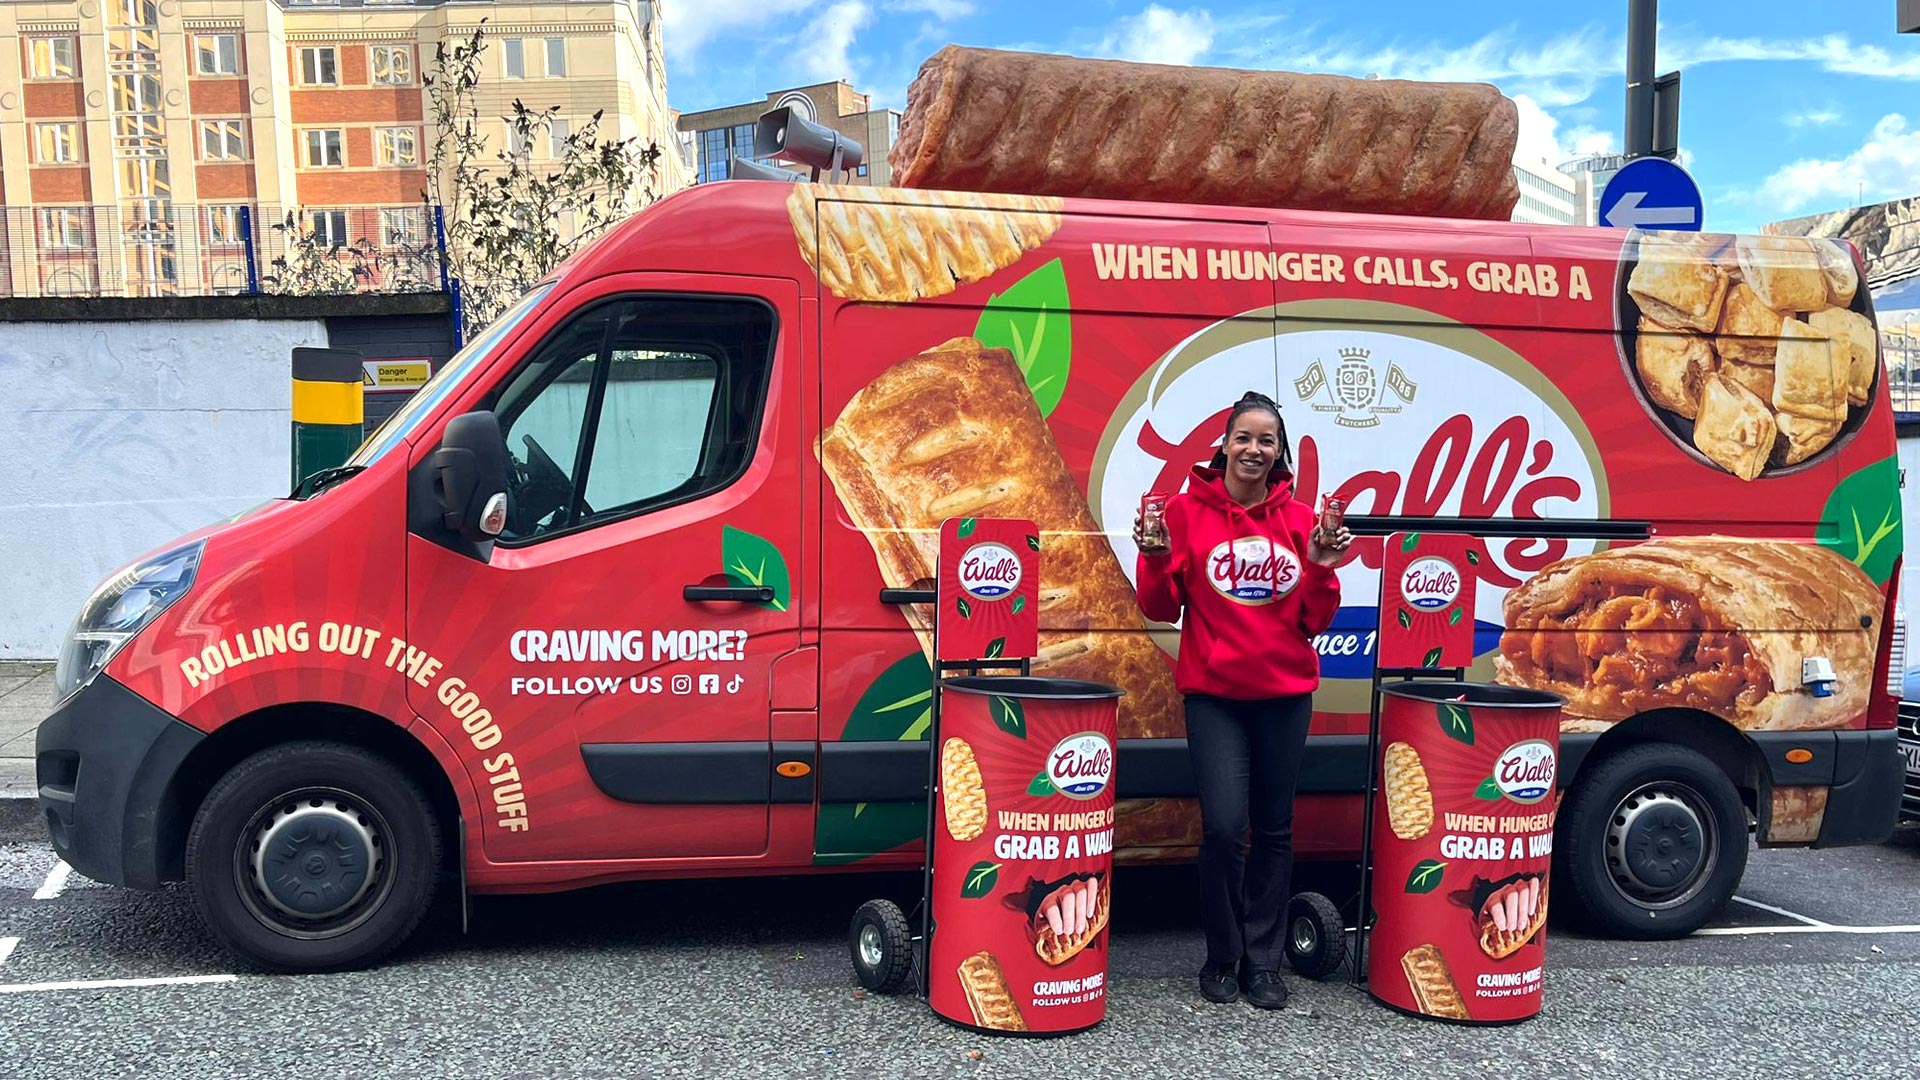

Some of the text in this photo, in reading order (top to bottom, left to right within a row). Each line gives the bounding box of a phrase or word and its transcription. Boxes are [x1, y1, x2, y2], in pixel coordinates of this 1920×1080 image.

[1091, 243, 1592, 301] WHEN HUNGER CALLS, GRAB A
[378, 368, 408, 376] Danger
[1299, 371, 1320, 395] ESTD
[964, 557, 1018, 583] Wall's
[1213, 553, 1296, 584] Wall's
[1405, 570, 1457, 596] Wall's
[510, 630, 748, 662] CRAVING MORE?
[1307, 634, 1360, 656] nce
[511, 676, 663, 695] FOLLOW US
[180, 622, 529, 833] ROLLING OUT THE GOOD STUFF
[1053, 747, 1110, 778] Wall's
[1500, 754, 1554, 784] Wall's
[998, 810, 1050, 832] WHEN
[1053, 810, 1105, 832] HUNGER
[1444, 812, 1496, 833] WHEN
[1499, 813, 1548, 834] HUNGER
[994, 834, 1060, 860] GRAB
[1064, 835, 1080, 859] A
[1440, 834, 1506, 860] GRAB
[1509, 837, 1524, 860] A
[1033, 979, 1080, 995] CRAVING
[1476, 972, 1522, 987] CRAVING
[1032, 995, 1081, 1006] FOLLOW US
[1475, 988, 1521, 997] FOLLOW US
